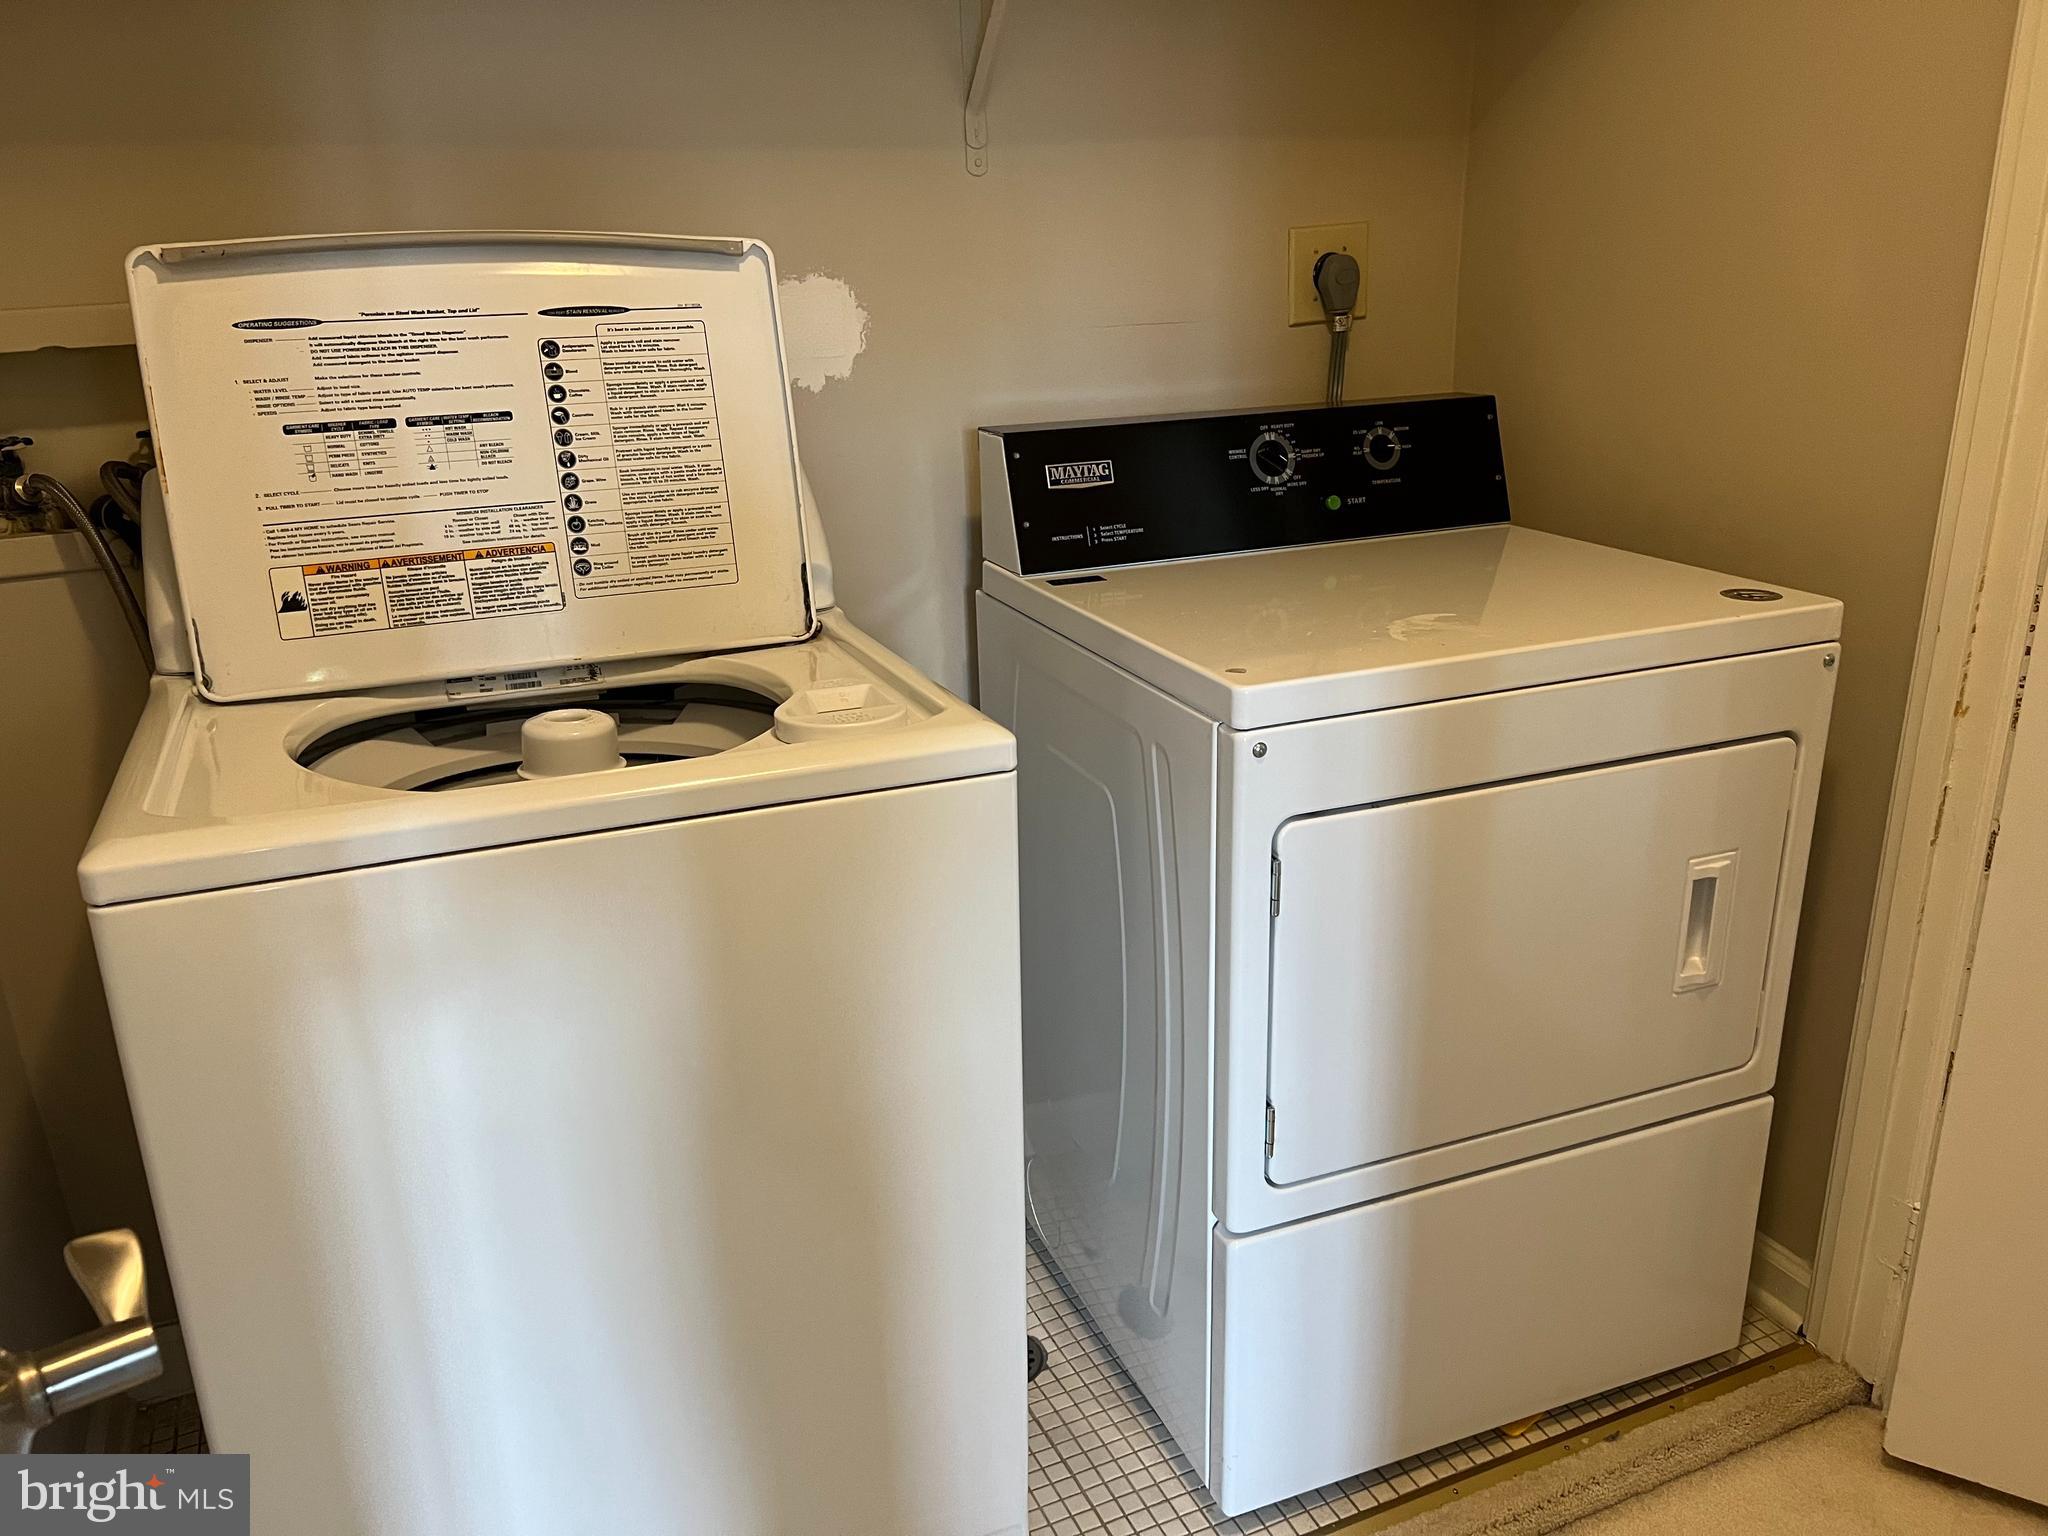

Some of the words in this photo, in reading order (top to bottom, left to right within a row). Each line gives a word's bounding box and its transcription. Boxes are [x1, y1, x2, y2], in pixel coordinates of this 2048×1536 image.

[1050, 463, 1110, 480] MAYTAG
[1347, 497, 1366, 505] START
[1052, 534, 1084, 542] INSTRUCTIONS
[486, 545, 546, 557] ADVERTENCIA
[391, 553, 462, 567] AVERTISSEMENT
[326, 561, 370, 573] WARNING
